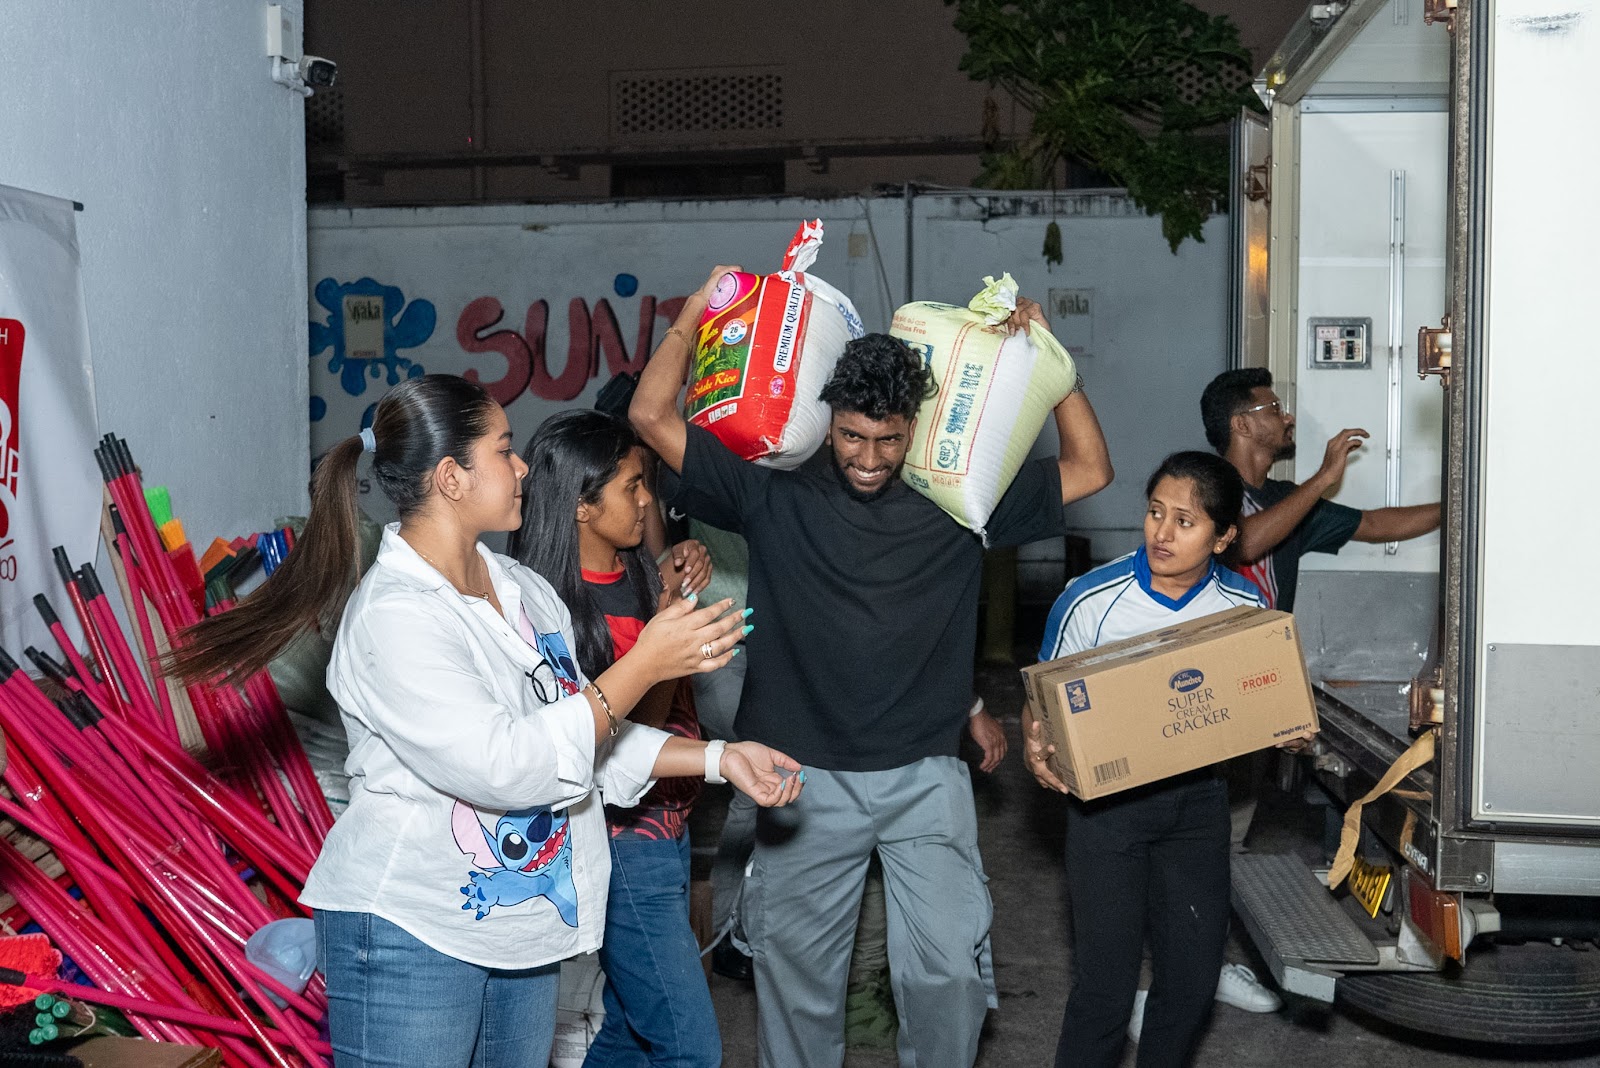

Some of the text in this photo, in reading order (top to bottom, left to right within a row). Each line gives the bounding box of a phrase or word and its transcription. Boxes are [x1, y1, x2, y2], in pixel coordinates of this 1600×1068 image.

[730, 326, 739, 334] 26
[777, 324, 794, 368] PREMIUM
[786, 284, 803, 323] QUALITY
[912, 326, 927, 335] Free
[714, 372, 737, 387] Rice
[959, 362, 984, 390] RICE
[939, 445, 951, 462] SRP
[1174, 675, 1203, 689] Munchee
[1242, 672, 1278, 691] PROMO
[1167, 687, 1215, 713] SUPER
[1176, 703, 1212, 720] CREAM
[1162, 707, 1231, 739] CRACKER
[1280, 727, 1294, 735] Weight
